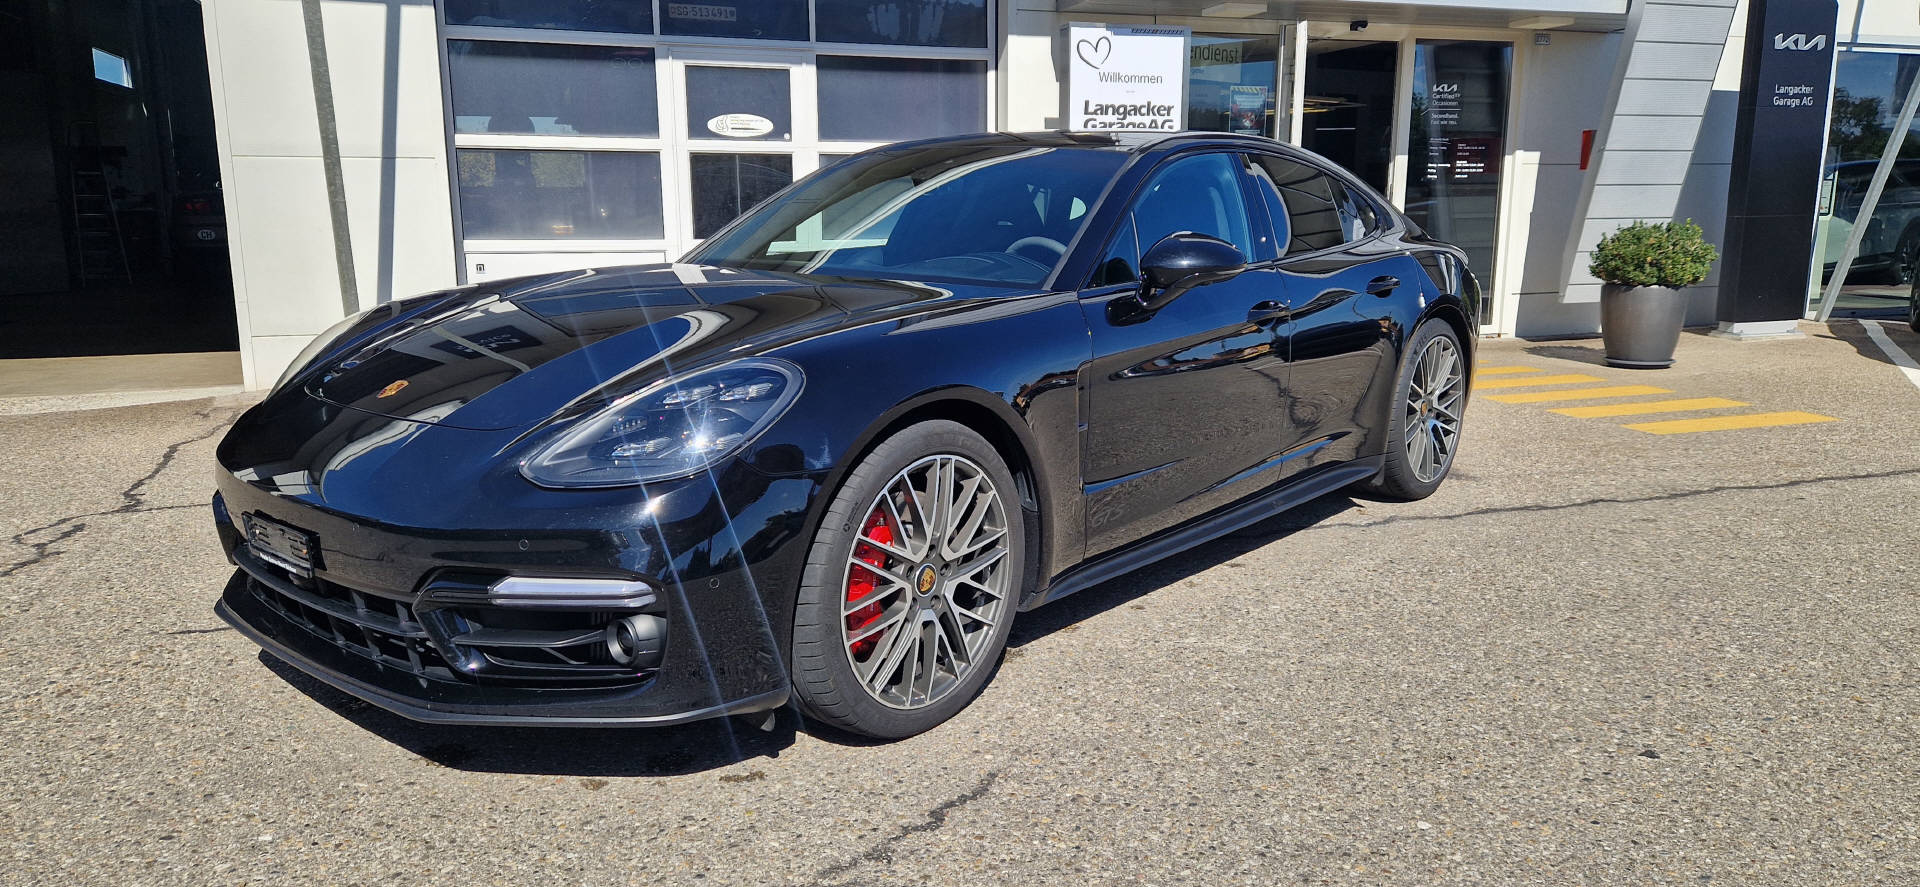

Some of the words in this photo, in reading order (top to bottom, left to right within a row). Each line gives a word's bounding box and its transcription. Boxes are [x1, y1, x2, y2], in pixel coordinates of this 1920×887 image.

[1774, 33, 1826, 51] KIA
[1098, 72, 1163, 84] Willkommen
[1775, 84, 1813, 95] Langacker
[1773, 96, 1800, 107] Garage
[1801, 96, 1814, 106] AG
[1084, 99, 1174, 120] Langacker
